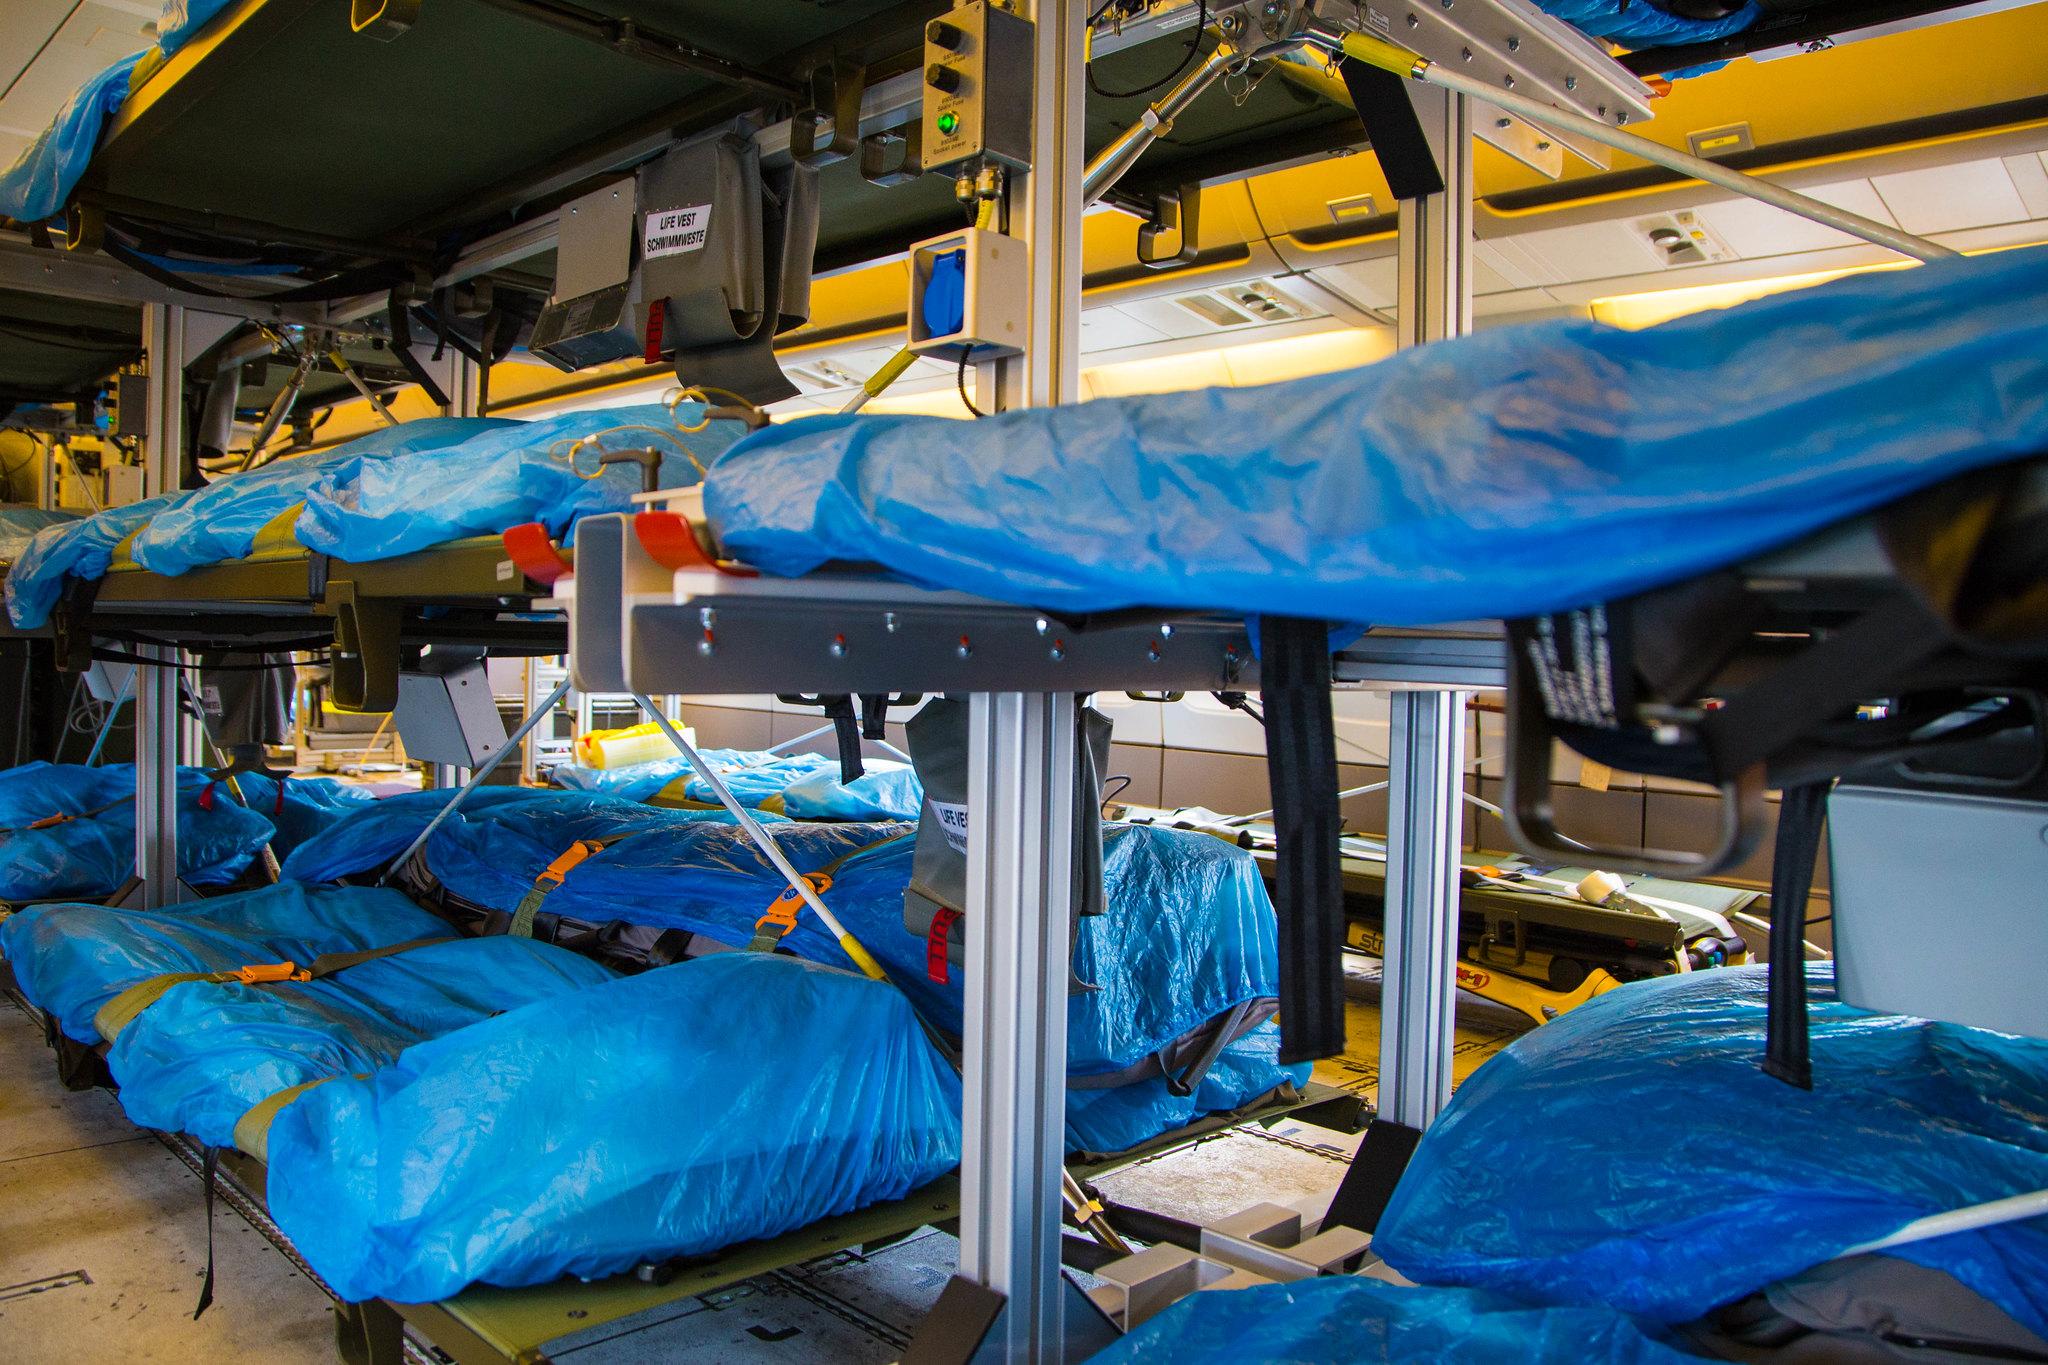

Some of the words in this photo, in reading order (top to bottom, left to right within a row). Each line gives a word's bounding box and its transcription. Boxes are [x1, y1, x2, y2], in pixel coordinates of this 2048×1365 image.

[660, 216, 676, 230] LIFE
[677, 213, 697, 227] VEST
[647, 230, 705, 252] SCHWIMMWESTE
[939, 808, 956, 826] LIFE
[1359, 932, 1383, 952] str
